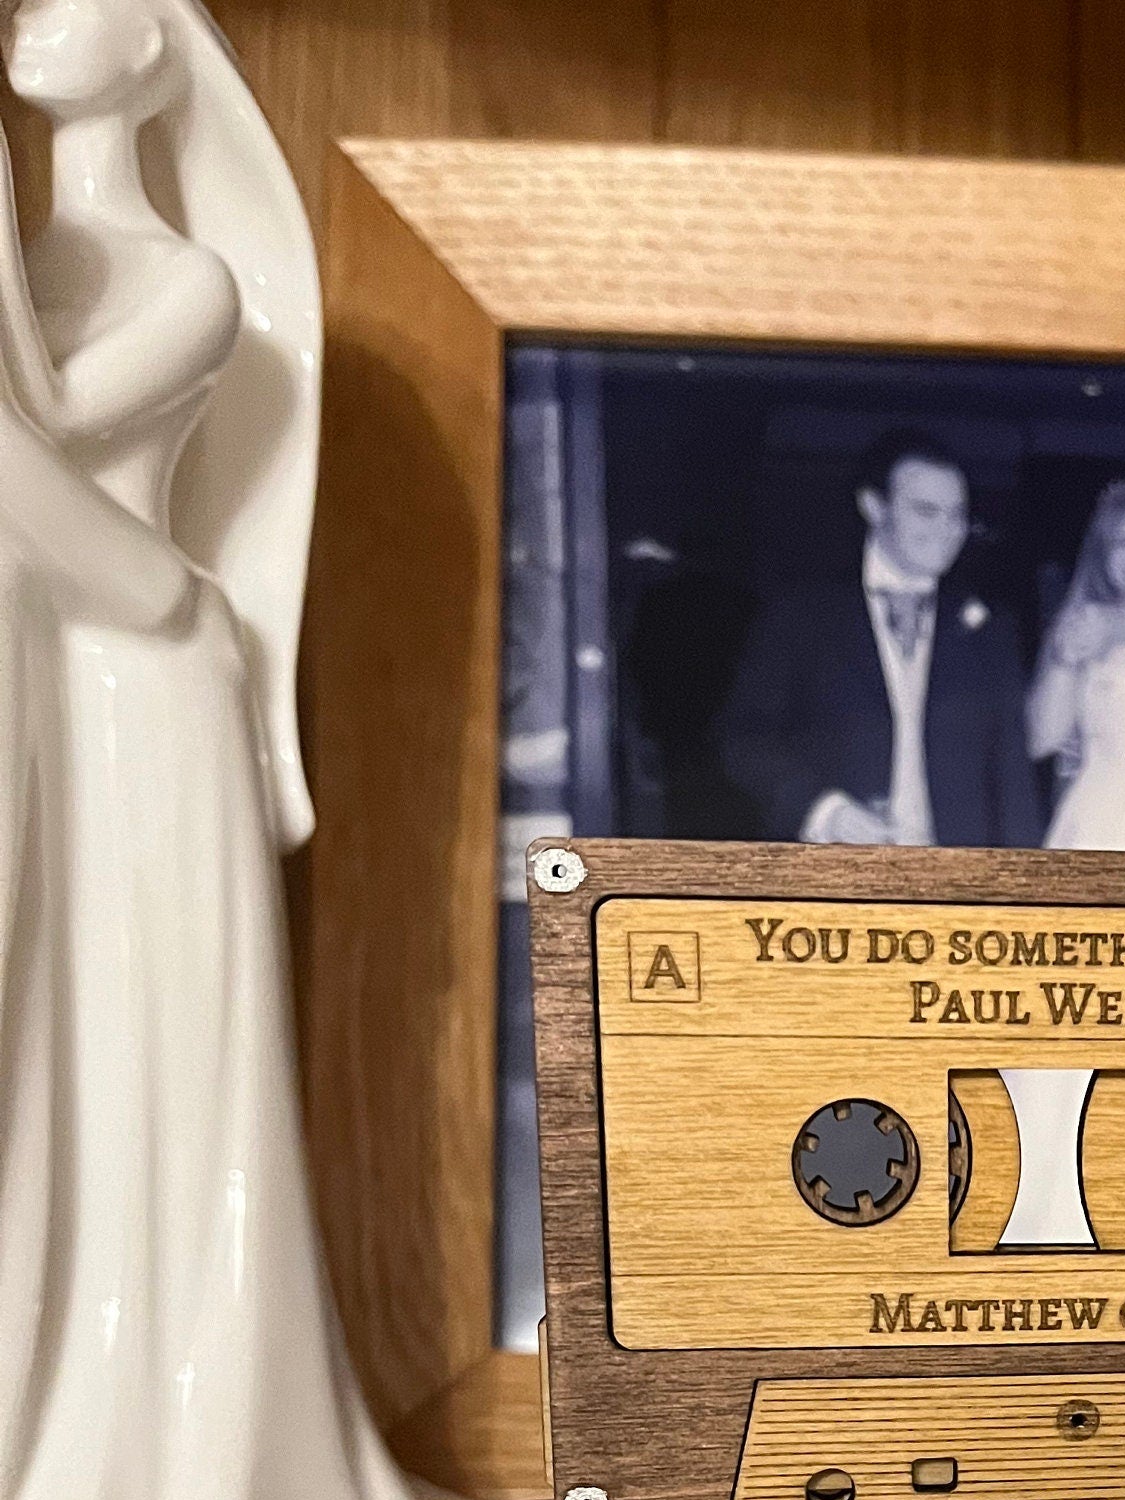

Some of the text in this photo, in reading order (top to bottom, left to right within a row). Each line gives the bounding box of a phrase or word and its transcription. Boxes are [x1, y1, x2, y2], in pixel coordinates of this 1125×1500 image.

[745, 917, 852, 963] YOU
[866, 928, 936, 966] DO
[643, 944, 687, 990] A
[909, 980, 1032, 1024] PAUL
[868, 1292, 1108, 1334] MATTHEW
